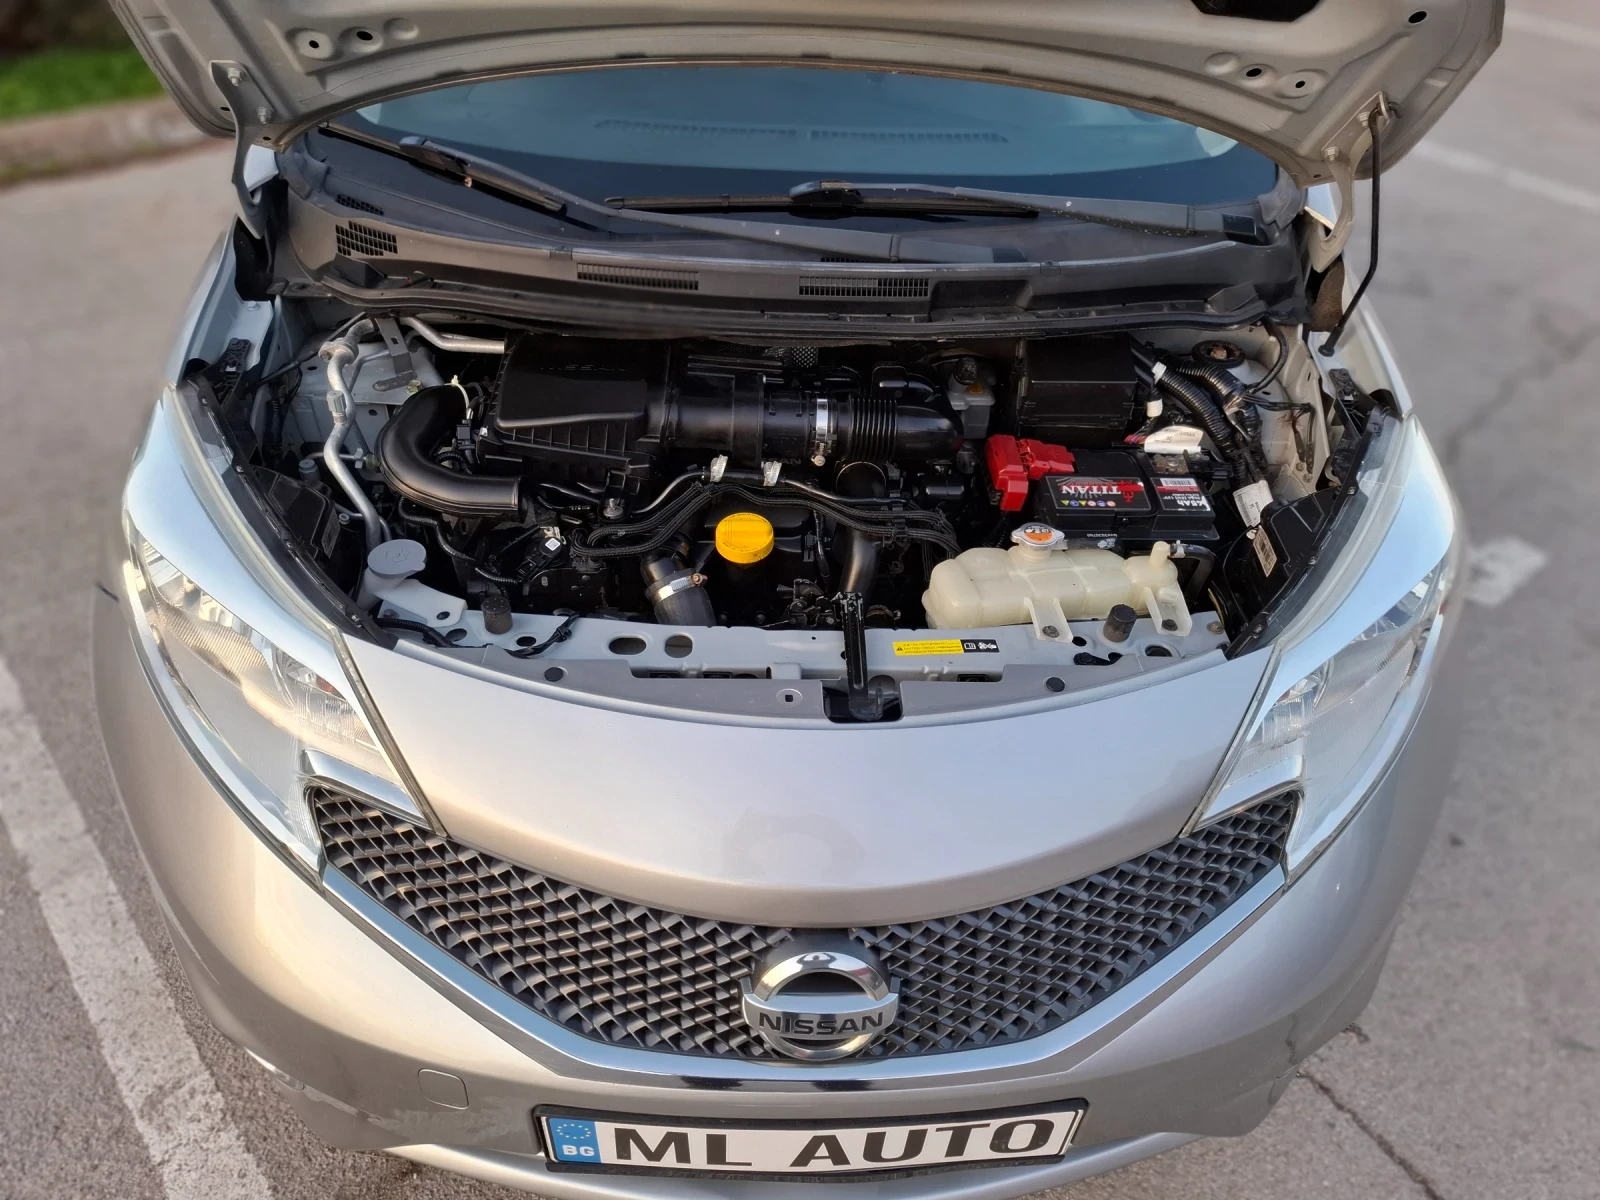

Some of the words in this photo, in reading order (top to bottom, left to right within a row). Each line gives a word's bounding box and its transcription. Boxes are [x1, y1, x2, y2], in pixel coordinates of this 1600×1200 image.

[1061, 485, 1121, 495] TITAN
[759, 1012, 883, 1035] NISSAN
[562, 1144, 595, 1157] BG
[614, 1127, 753, 1167] ML
[789, 1119, 1055, 1168] AUTO
